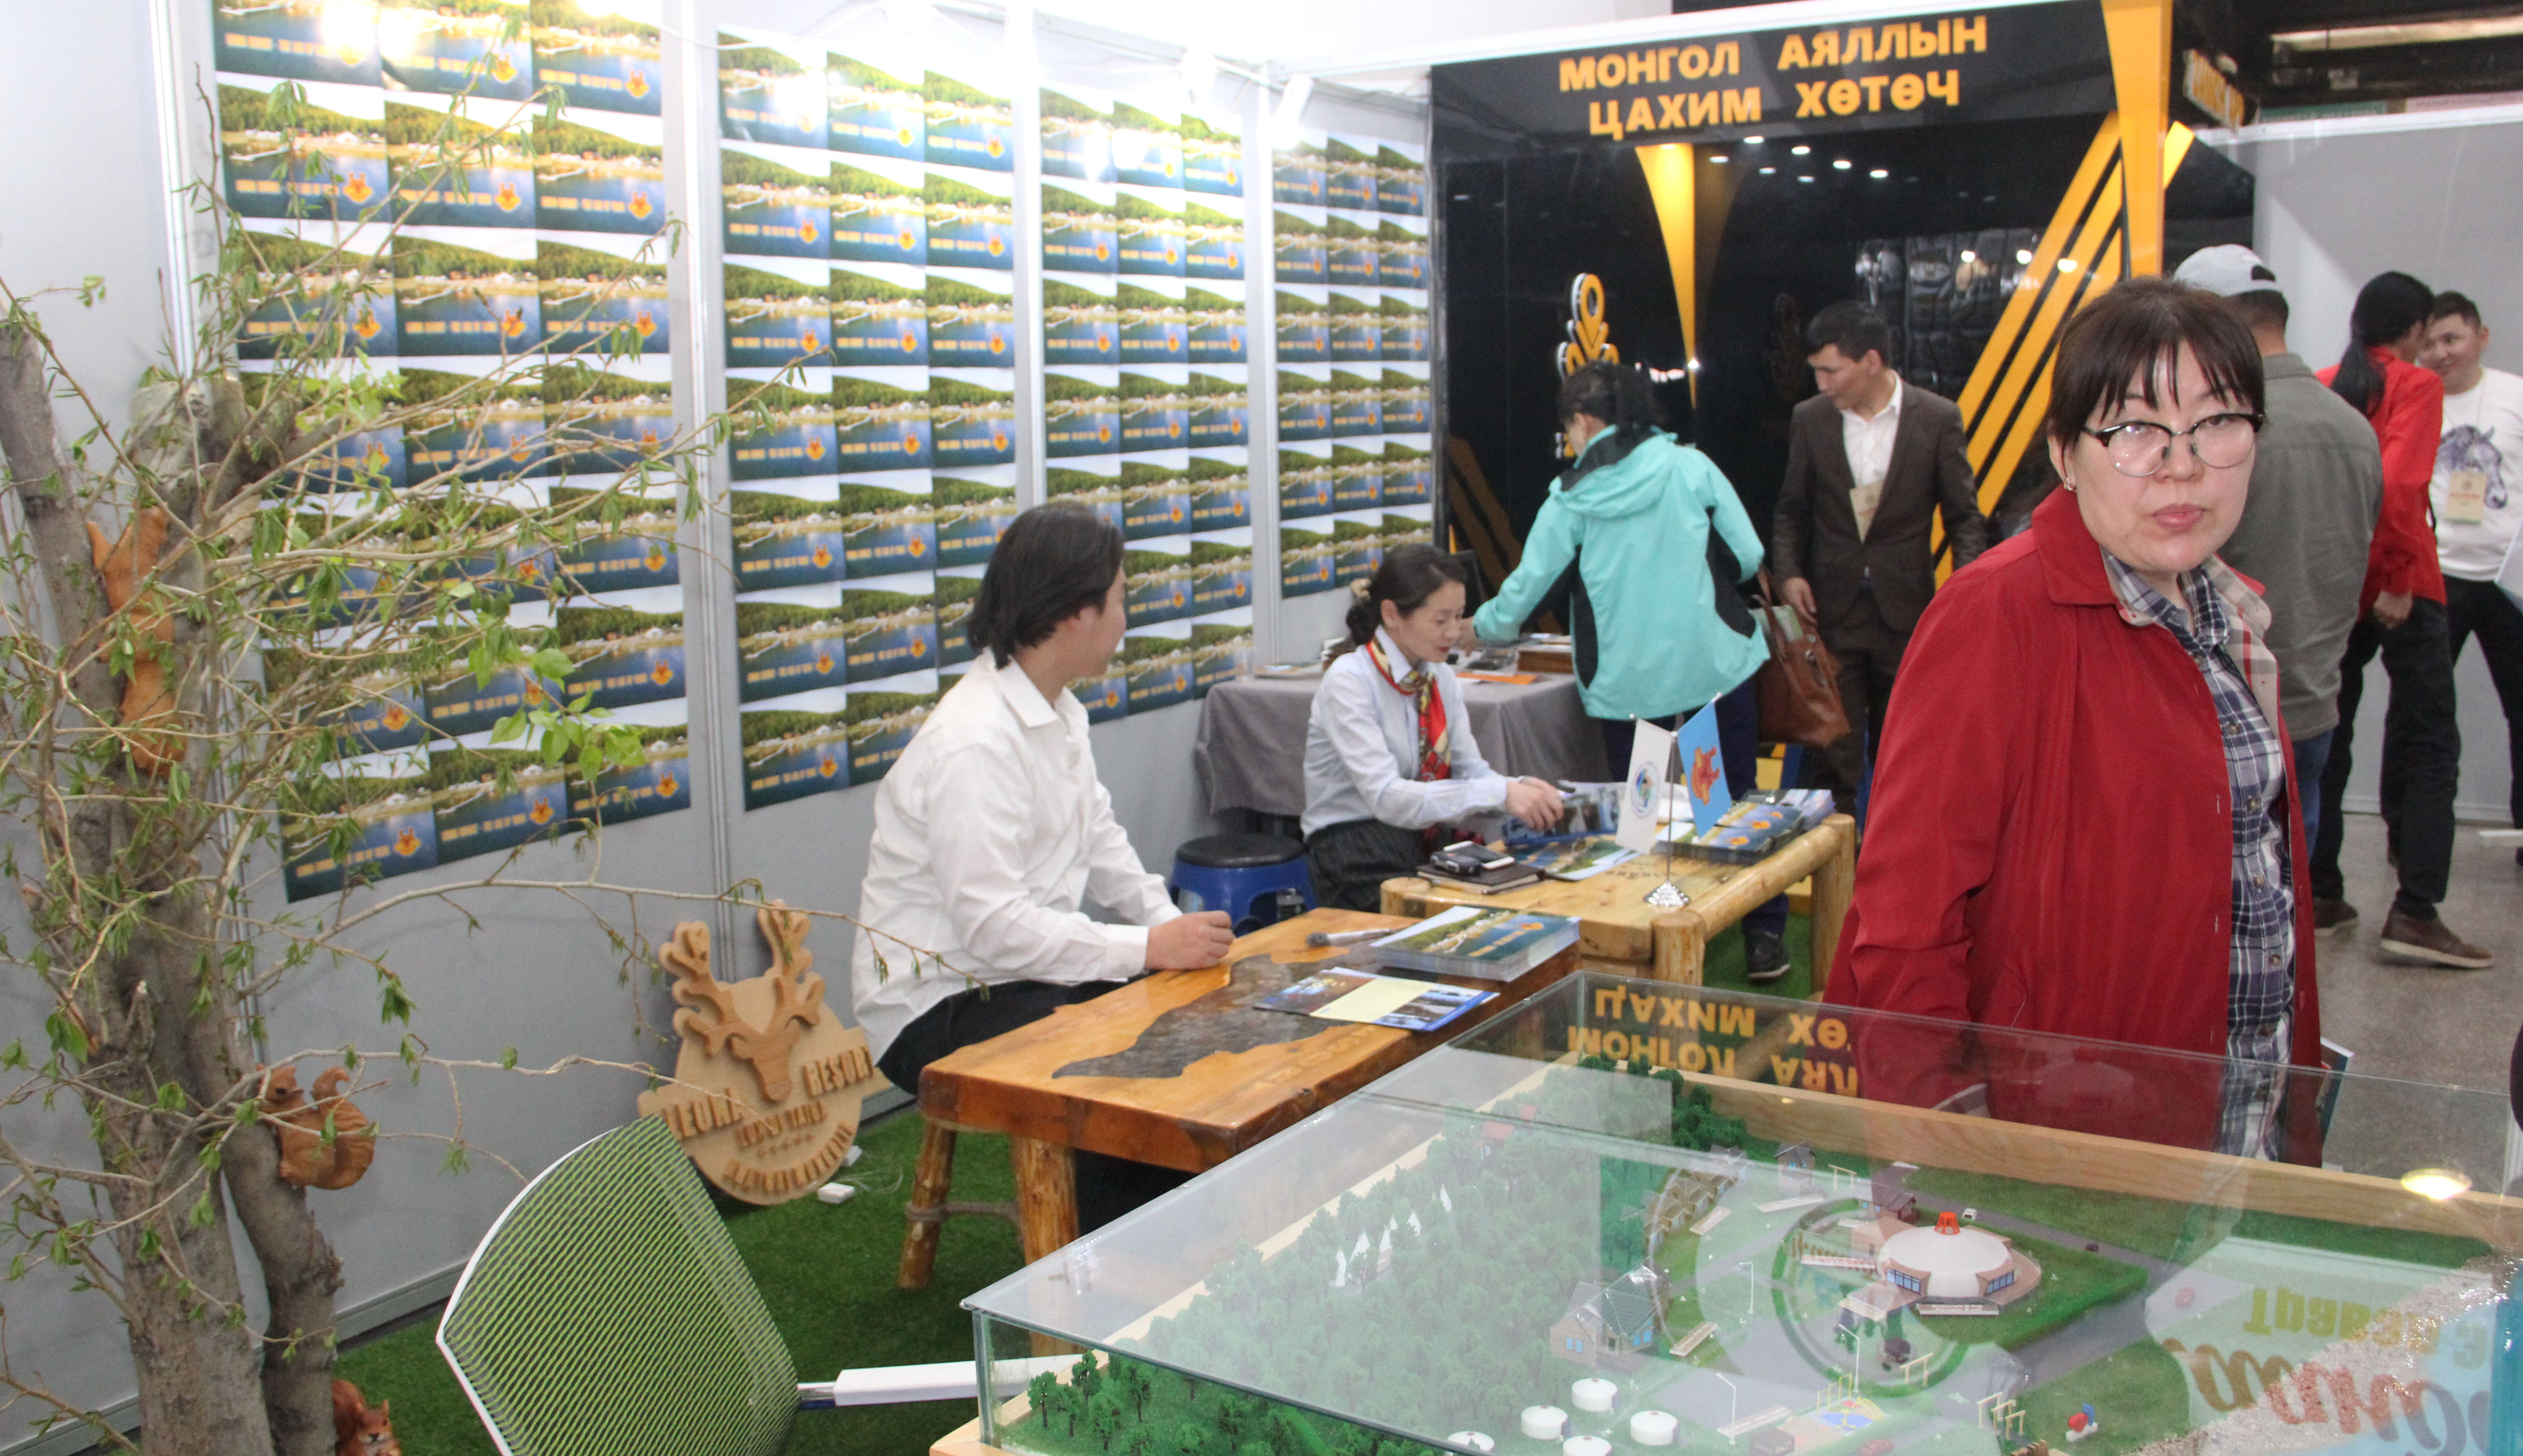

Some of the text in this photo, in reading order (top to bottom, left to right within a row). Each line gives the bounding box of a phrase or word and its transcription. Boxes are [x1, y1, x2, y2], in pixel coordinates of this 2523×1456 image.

[1559, 16, 1988, 92] МОНГОЛ АЯЛЛЫН
[1589, 69, 1961, 141] ЦАХИМ ХӨТӨЧ
